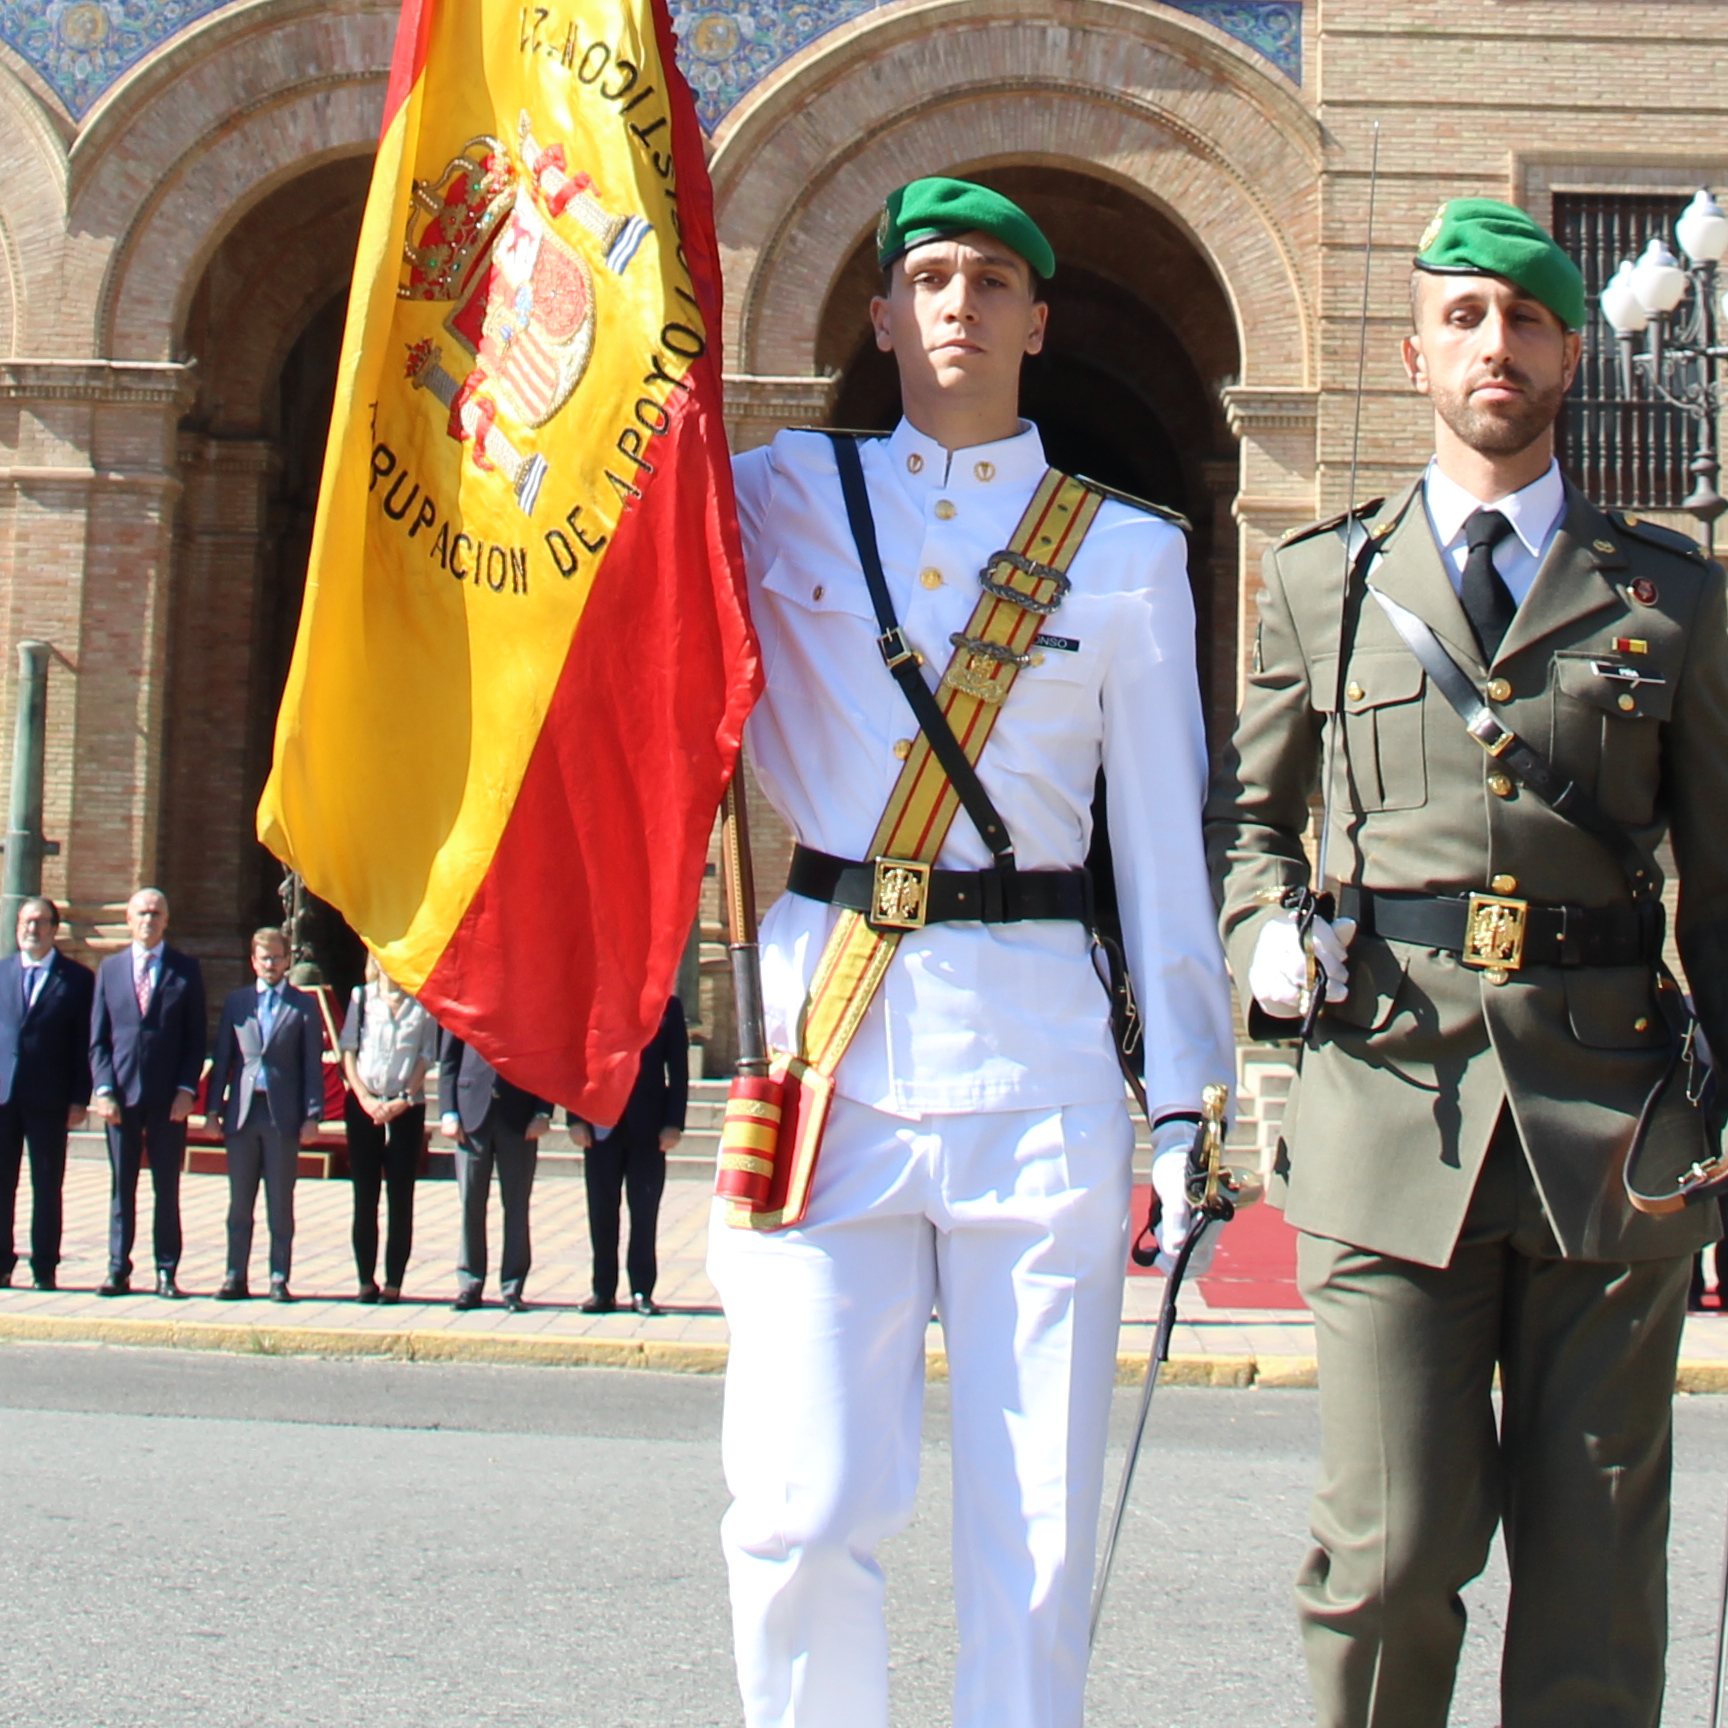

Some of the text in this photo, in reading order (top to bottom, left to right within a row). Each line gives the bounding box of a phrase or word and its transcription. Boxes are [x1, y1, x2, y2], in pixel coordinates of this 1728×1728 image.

[519, 7, 550, 54] 21
[603, 321, 706, 512] APOYO
[544, 504, 608, 579] DE
